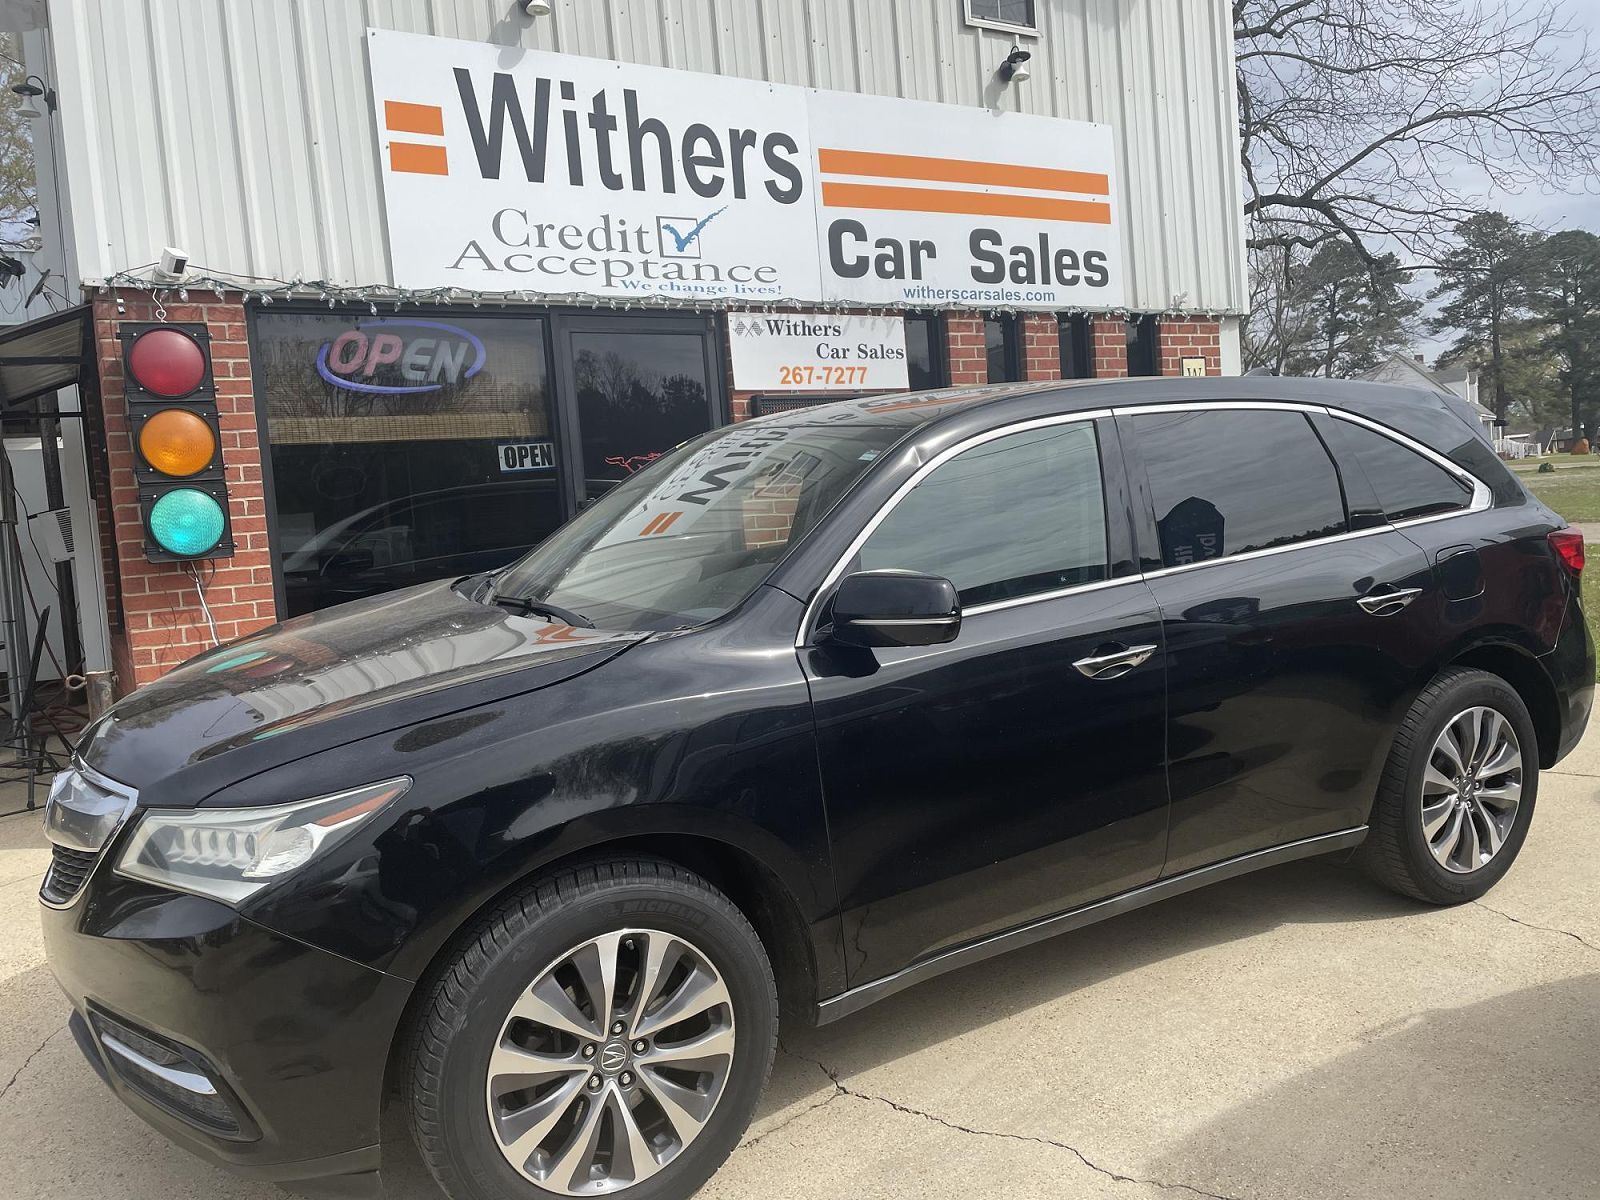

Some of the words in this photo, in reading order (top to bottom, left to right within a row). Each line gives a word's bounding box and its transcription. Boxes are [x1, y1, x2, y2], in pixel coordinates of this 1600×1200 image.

[453, 67, 803, 205] Withers
[492, 208, 655, 255] Credit
[445, 239, 779, 288] Acceptance
[827, 218, 937, 281] Car
[969, 228, 1110, 288] Sales
[620, 279, 654, 291] We
[658, 282, 728, 295] change
[734, 283, 782, 295] lives!
[903, 285, 1056, 302] witherscarsales.com
[765, 319, 842, 337] Withers
[329, 330, 470, 385] OPEN
[816, 343, 850, 360] Car
[857, 344, 905, 360] Sales
[779, 366, 868, 385] 267-7277
[503, 443, 555, 469] OPEN
